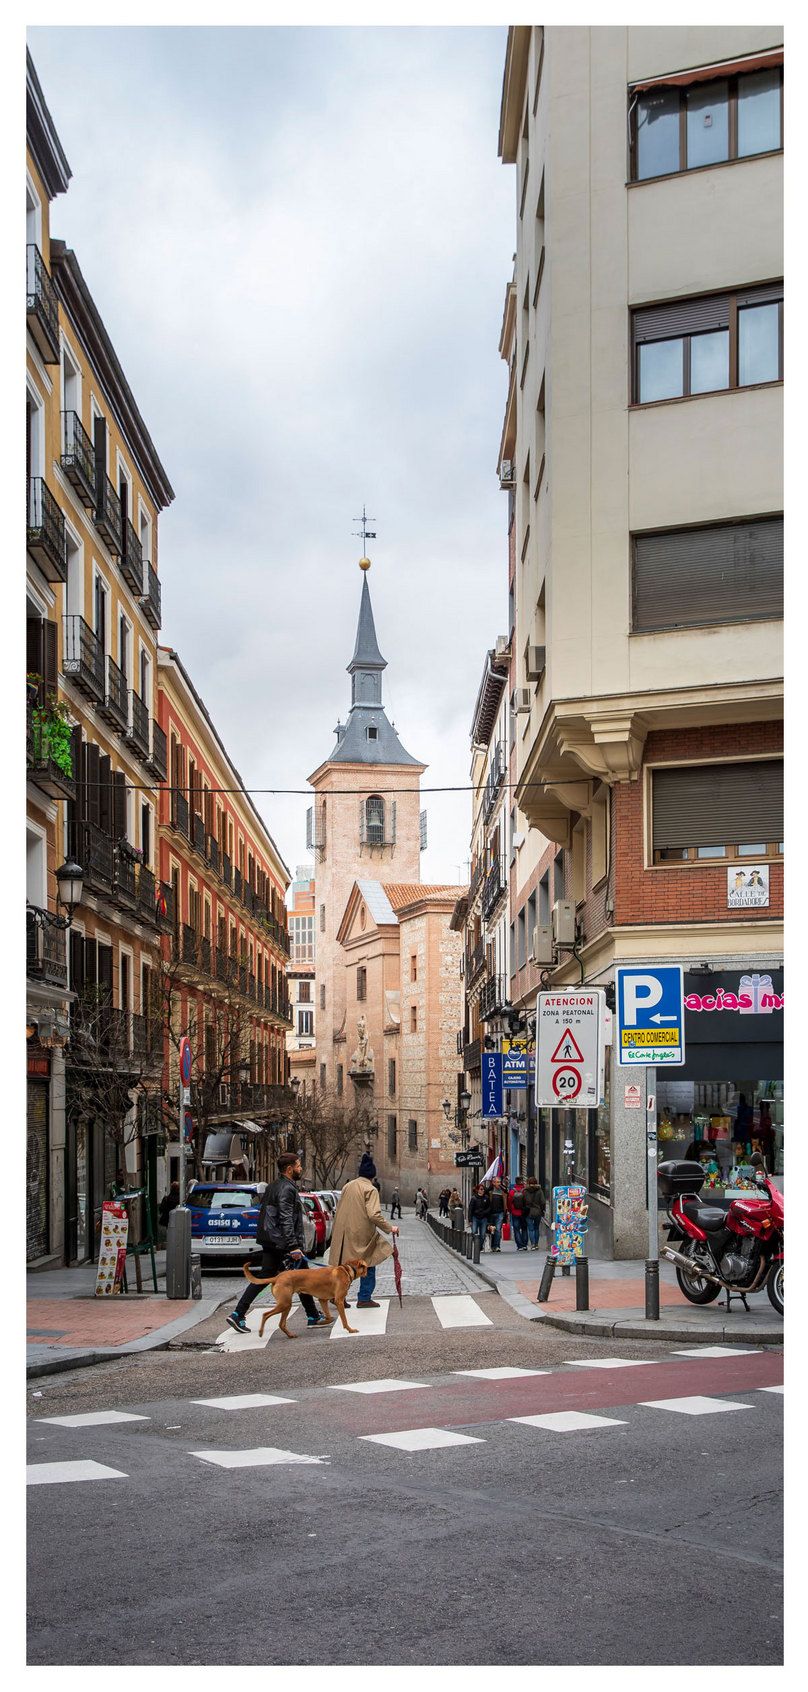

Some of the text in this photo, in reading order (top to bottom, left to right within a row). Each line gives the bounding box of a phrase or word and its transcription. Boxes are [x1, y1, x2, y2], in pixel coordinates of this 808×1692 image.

[545, 998, 593, 1006] ATENCION
[623, 975, 663, 1026] P
[684, 988, 753, 1011] acias
[624, 1032, 677, 1043] CENTRO COMERCIAL
[488, 1058, 497, 1113] BATEA
[559, 1077, 576, 1088] 20
